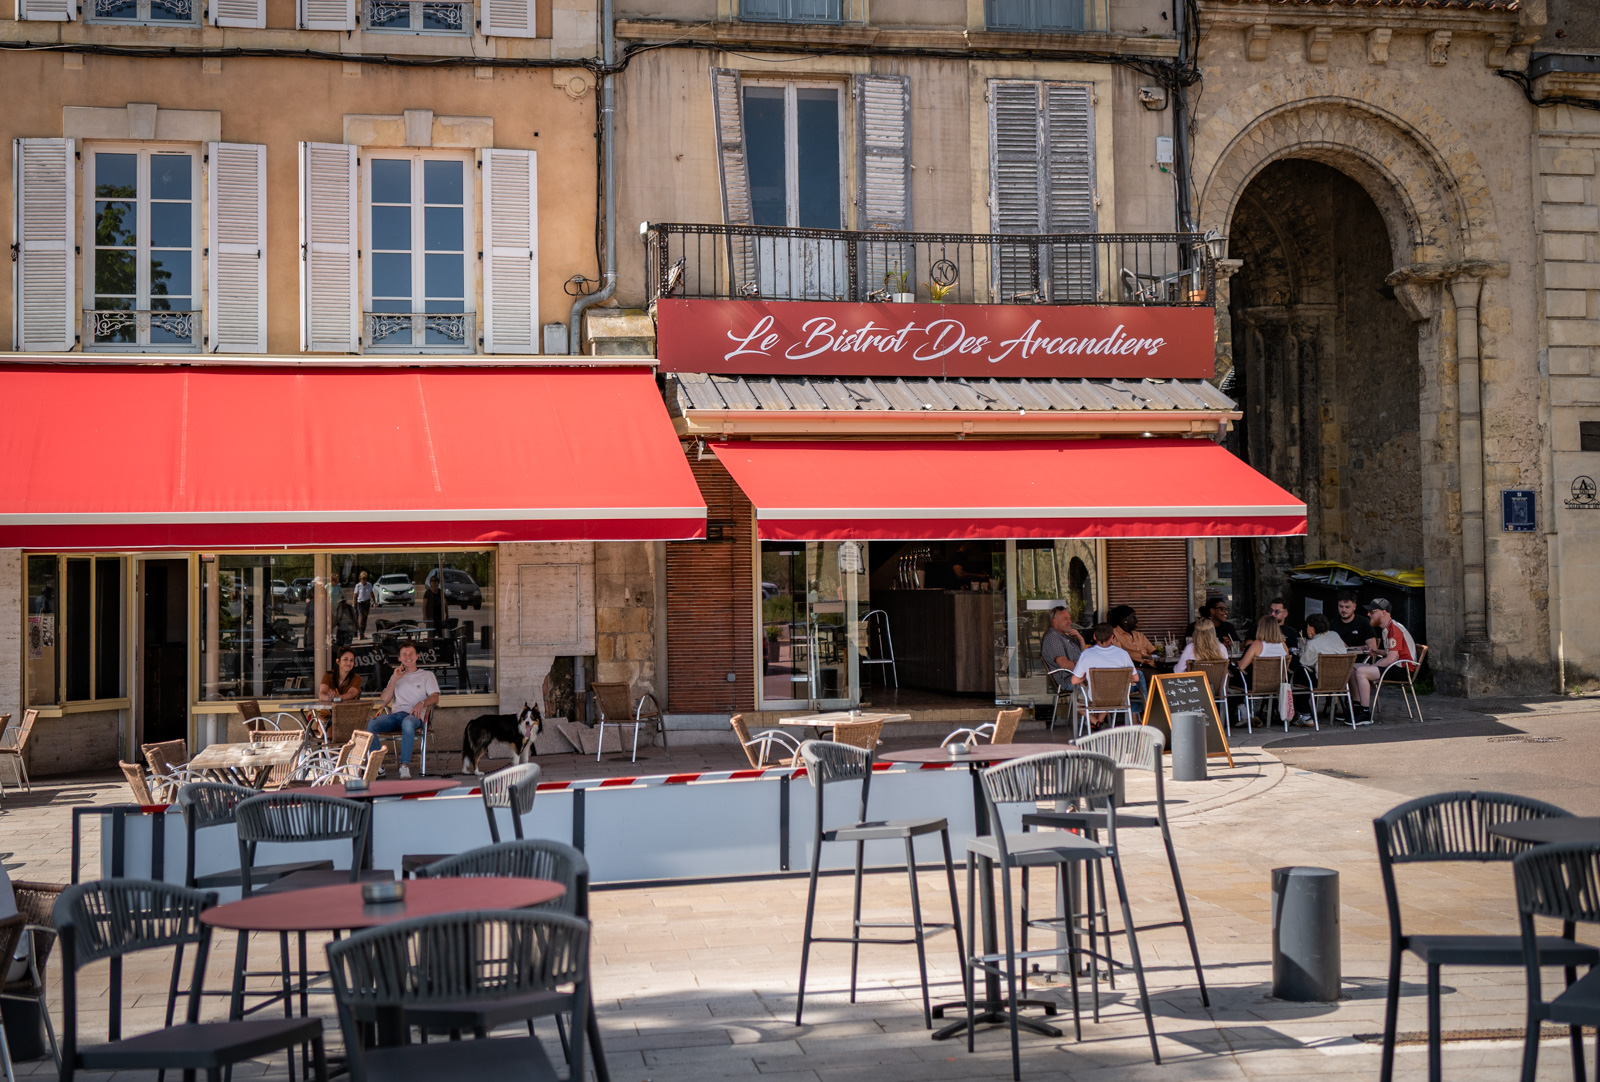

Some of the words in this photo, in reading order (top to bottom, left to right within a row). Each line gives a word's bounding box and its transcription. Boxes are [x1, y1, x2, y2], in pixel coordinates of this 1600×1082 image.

[724, 315, 781, 361] Le
[785, 316, 926, 360] Bistrot
[913, 318, 992, 361] Des
[988, 319, 1168, 363] Arcandiers
